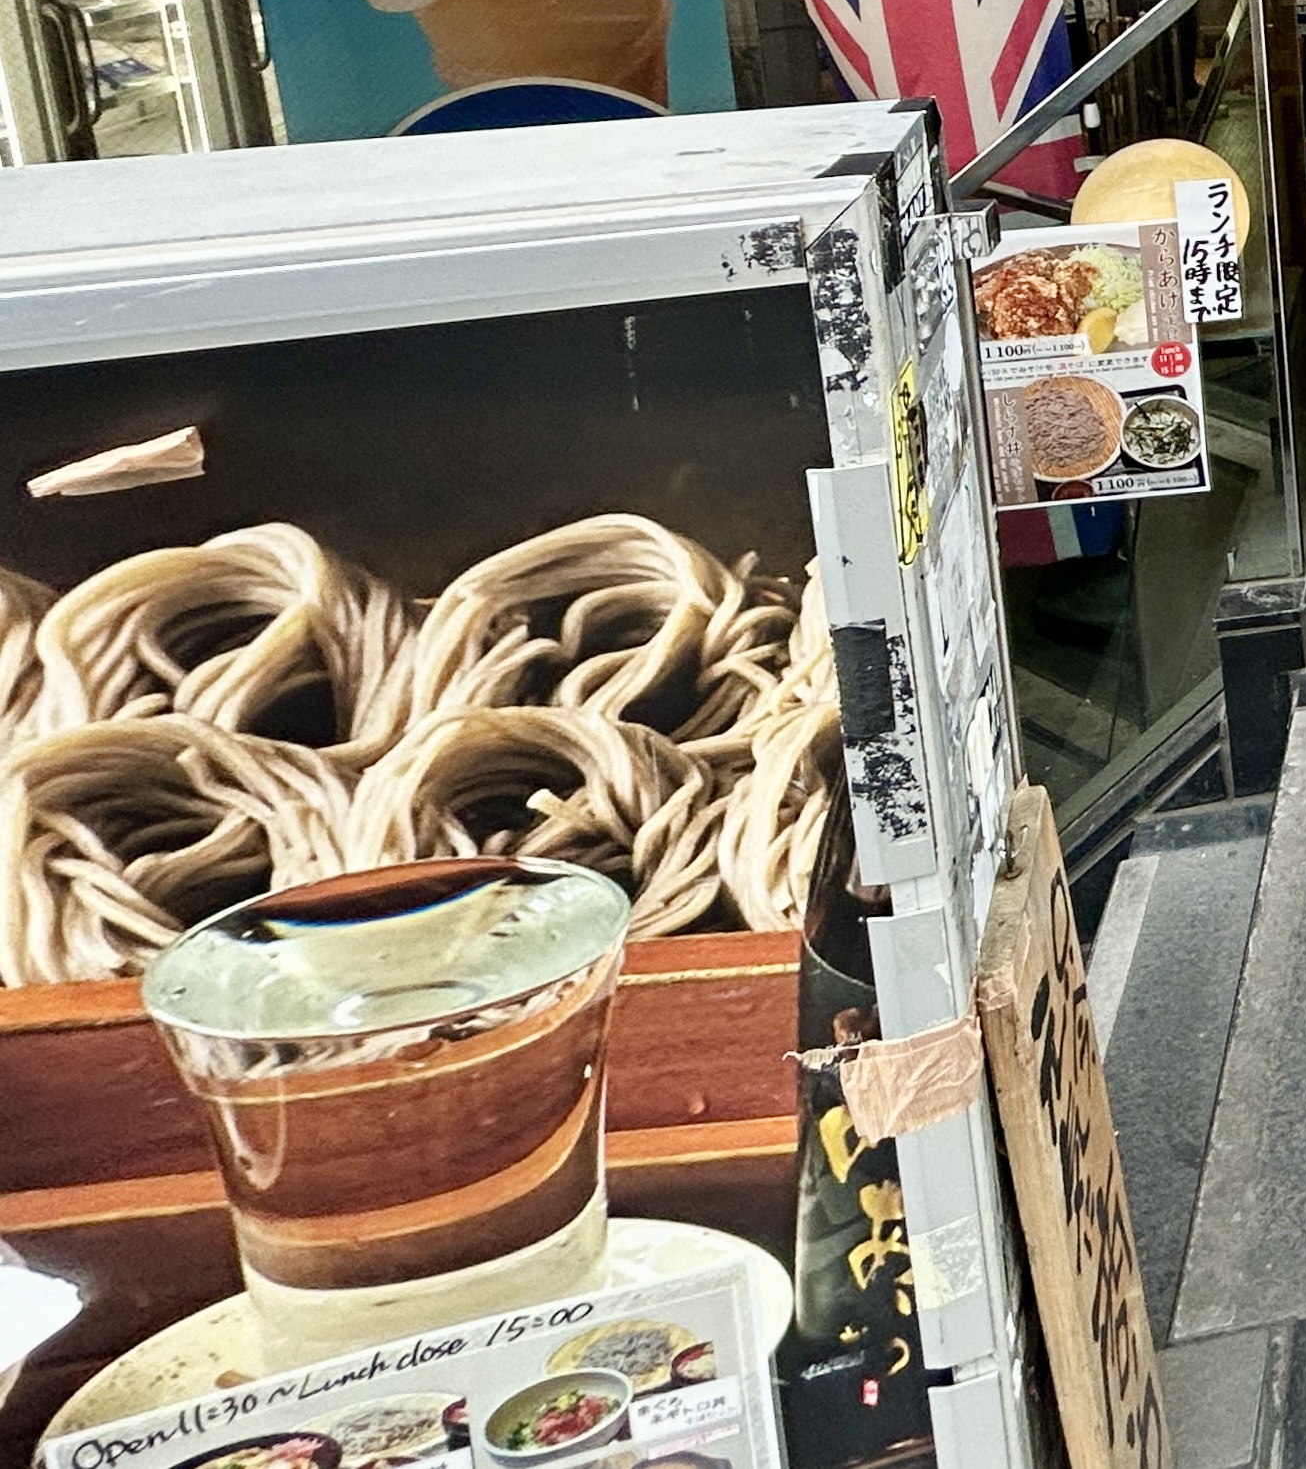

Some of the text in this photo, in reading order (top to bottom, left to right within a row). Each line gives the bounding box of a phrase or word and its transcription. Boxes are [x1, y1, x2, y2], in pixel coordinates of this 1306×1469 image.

[1207, 182, 1241, 315] ランチ限定
[71, 1431, 174, 1469] Open
[297, 1351, 391, 1400] Lunch
[395, 1338, 468, 1373] close
